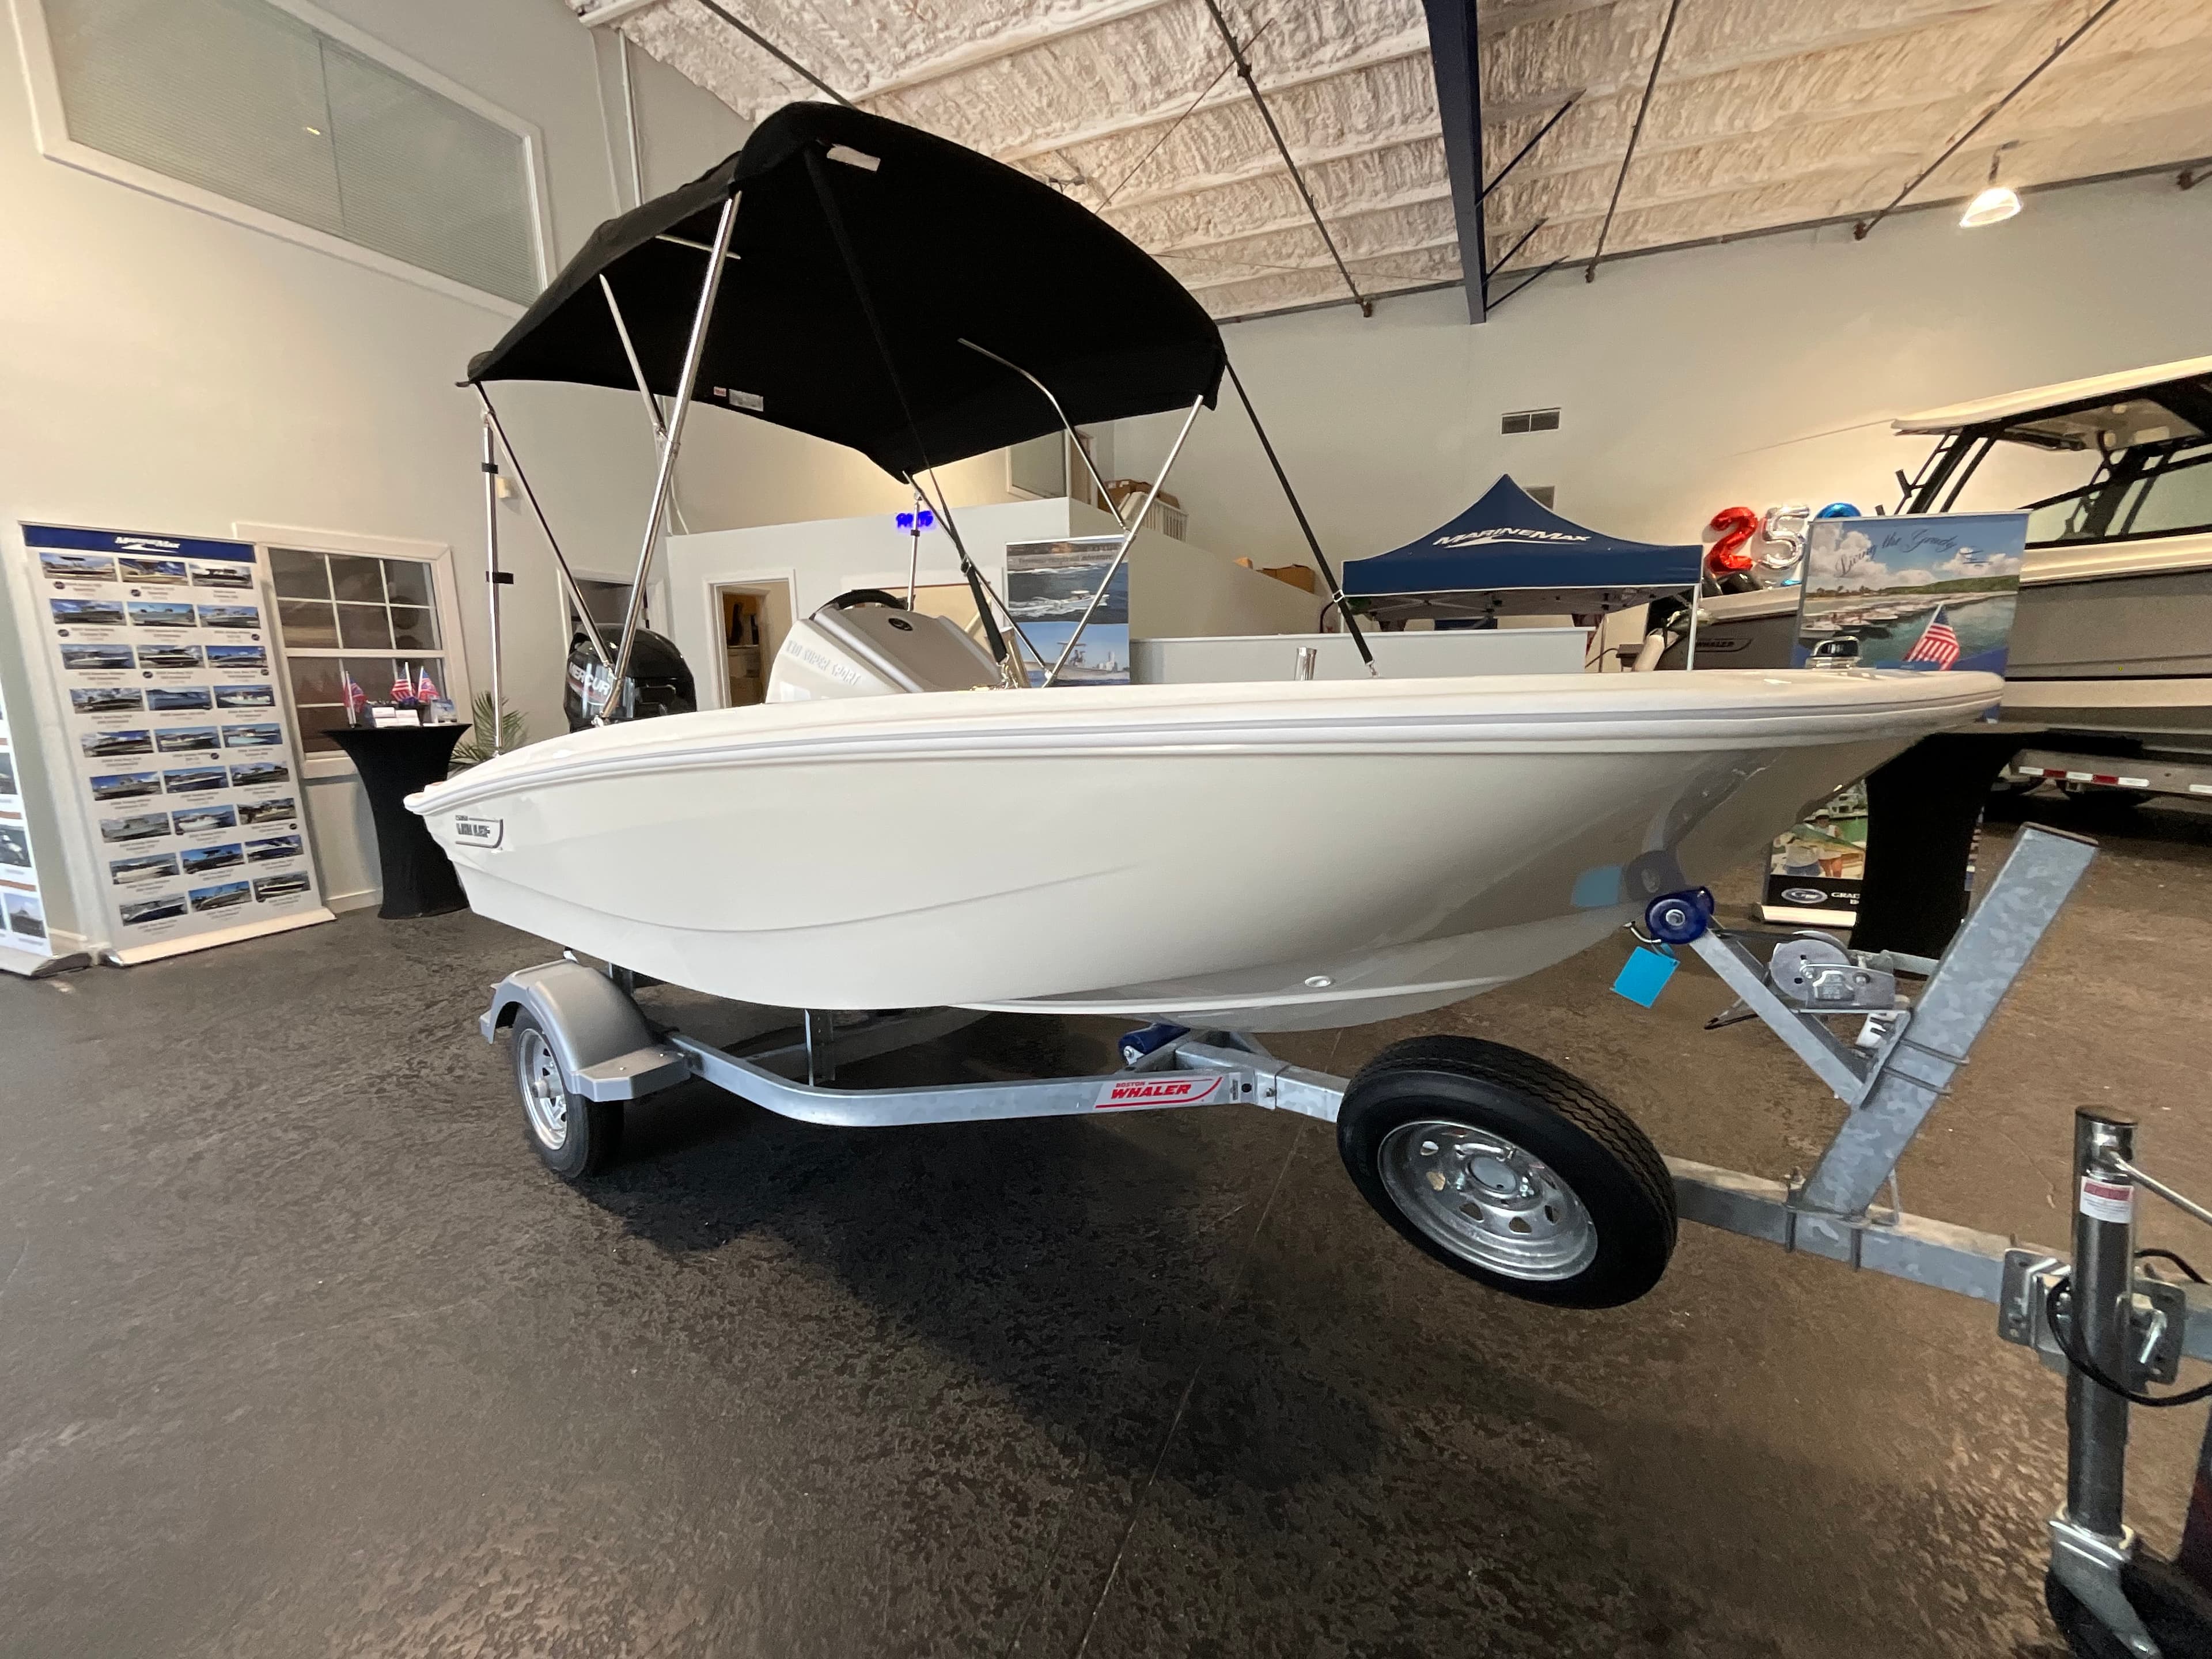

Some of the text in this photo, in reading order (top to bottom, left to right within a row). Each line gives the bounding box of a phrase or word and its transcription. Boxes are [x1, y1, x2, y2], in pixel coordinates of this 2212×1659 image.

[1706, 503, 1861, 574] 25
[1834, 528, 1959, 578] Living the Grady
[567, 661, 612, 696] MERCUR
[1110, 1084, 1192, 1100] WHALER
